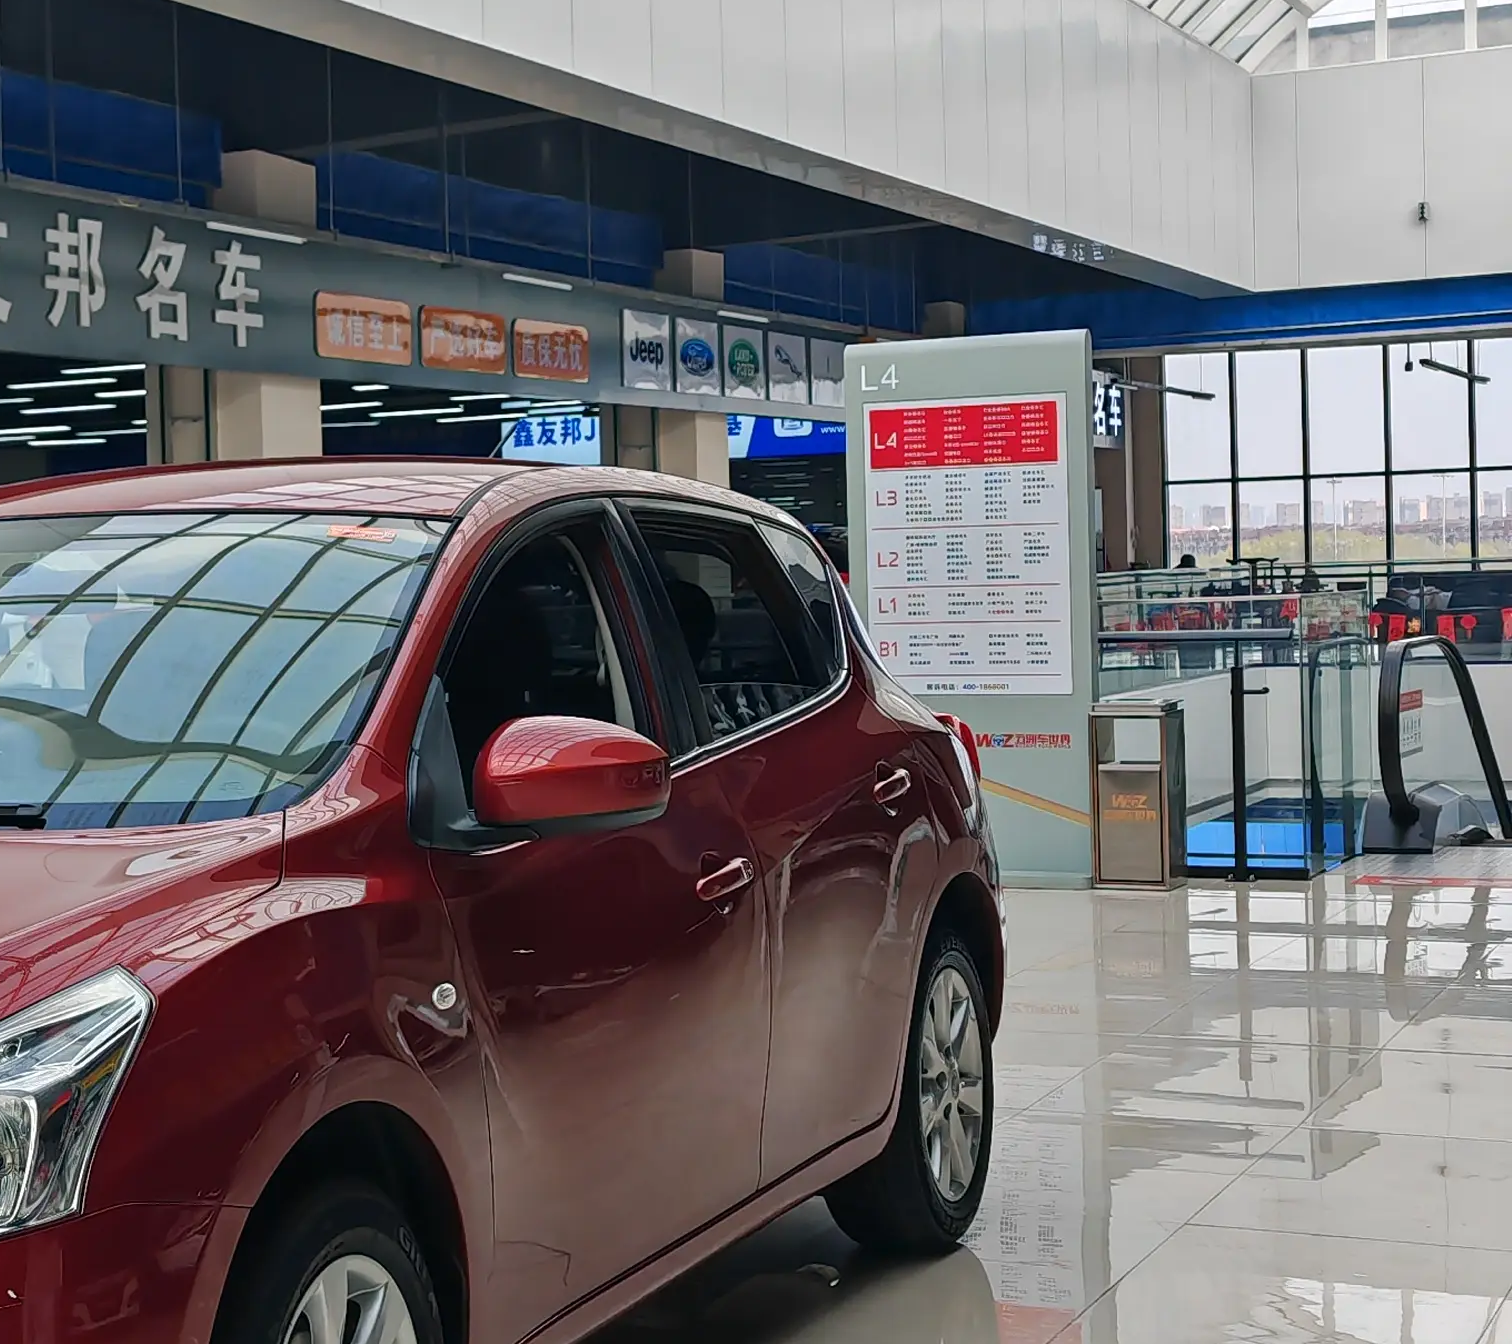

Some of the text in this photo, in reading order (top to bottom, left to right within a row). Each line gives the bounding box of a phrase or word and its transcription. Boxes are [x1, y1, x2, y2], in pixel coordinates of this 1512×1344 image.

[522, 330, 583, 372] 质保无忧
[630, 331, 664, 371] Jeep
[860, 362, 900, 392] L4
[1094, 381, 1122, 437] 名车
[874, 431, 897, 450] L4
[876, 490, 898, 507] L3
[877, 551, 899, 568] L2
[878, 597, 898, 614] L1
[879, 641, 898, 657] B1
